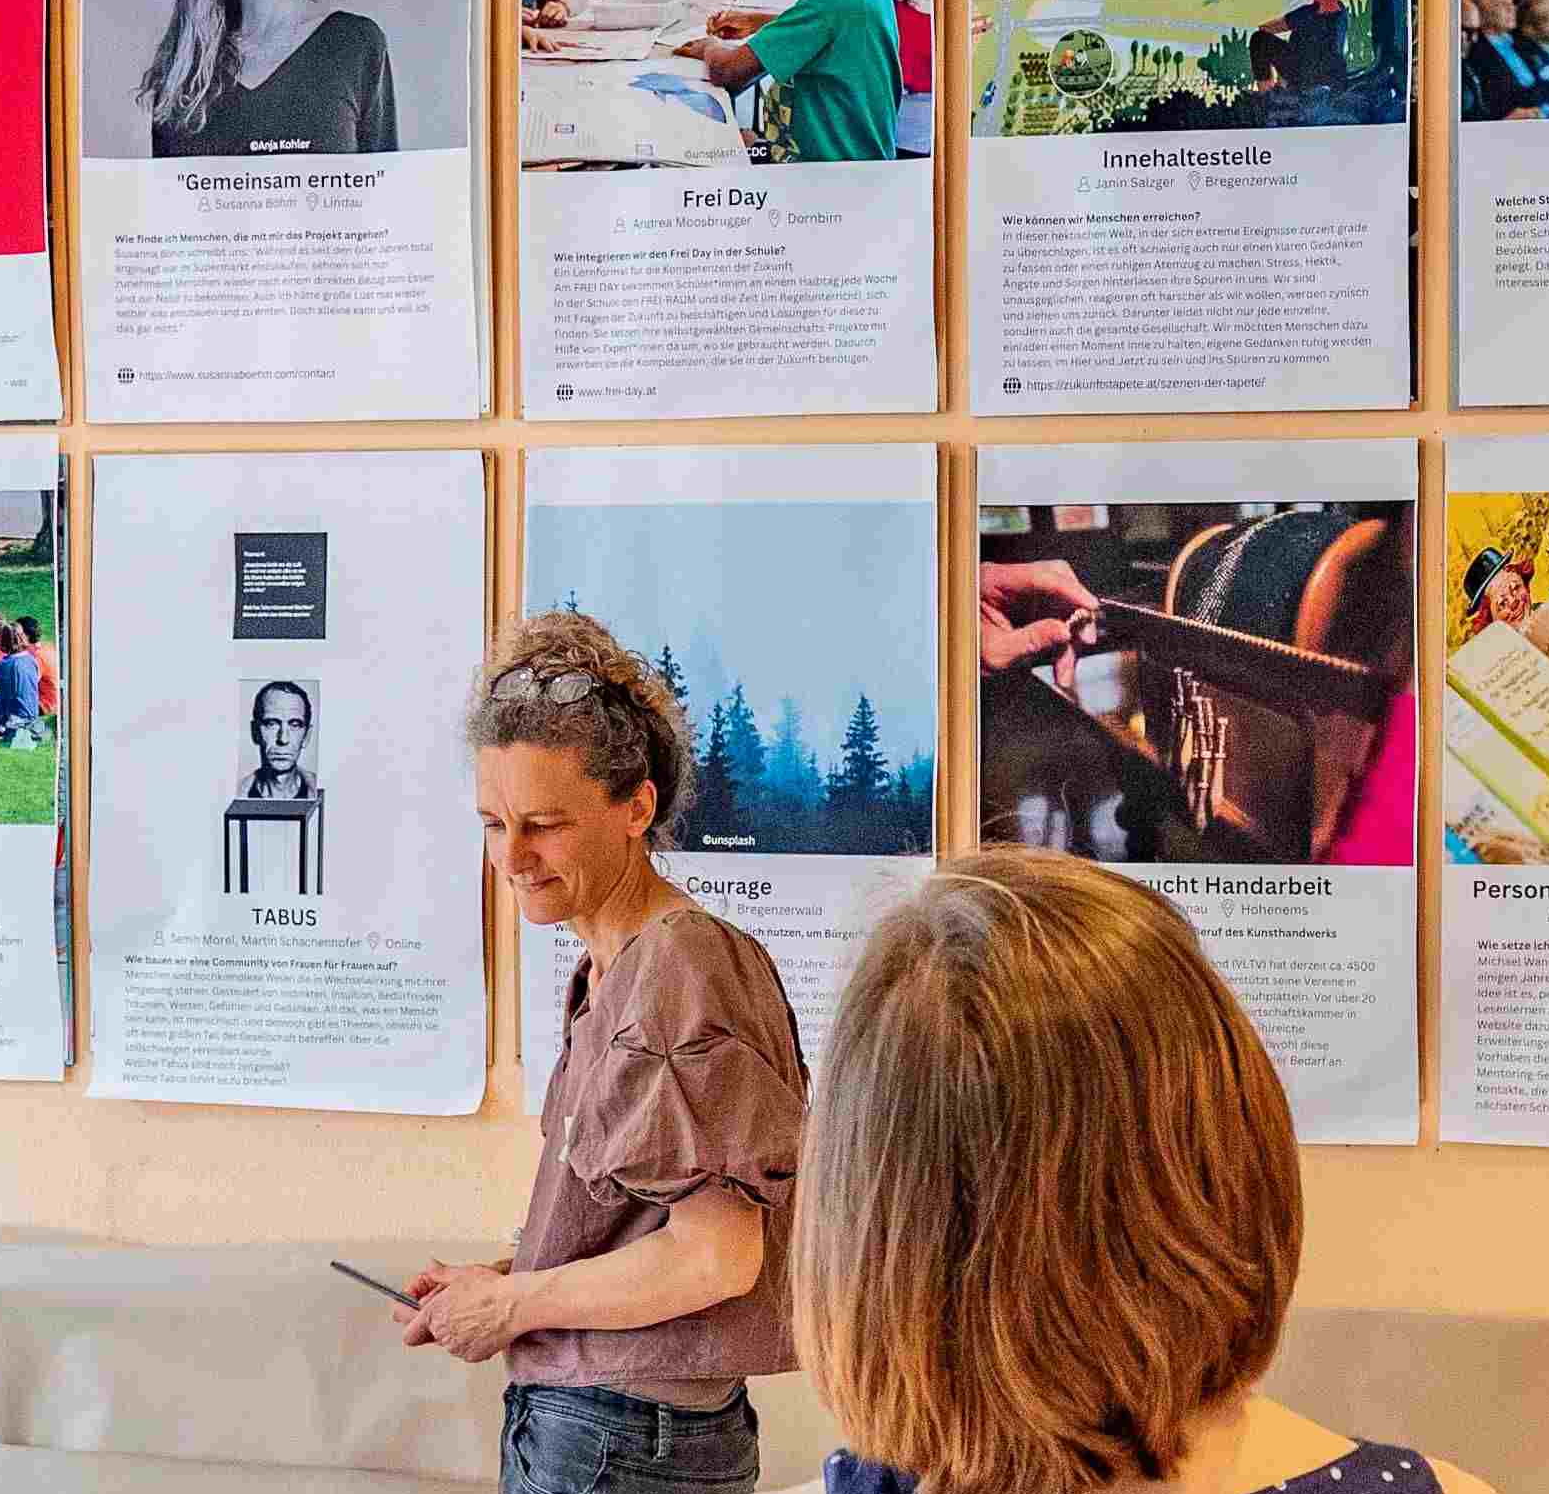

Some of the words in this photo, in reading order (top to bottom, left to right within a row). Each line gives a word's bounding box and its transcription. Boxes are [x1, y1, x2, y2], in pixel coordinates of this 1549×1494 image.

[1103, 146, 1272, 169] Innehaltestelle
[177, 173, 301, 191] "Gemeinsam
[307, 170, 385, 189] ernten"
[1205, 172, 1299, 190] Bregenzerwald
[322, 195, 363, 212] Lindau
[683, 188, 722, 208] Frei
[728, 188, 768, 211] Day
[1494, 195, 1536, 207] Welche
[675, 215, 753, 229] Moosbrugger
[787, 211, 843, 225] Dornbirn
[686, 876, 773, 900] Courage
[1205, 875, 1333, 896] Handarbeit
[251, 908, 317, 927] TABUS
[737, 903, 823, 918] Bregenzerwald
[1241, 903, 1309, 916] Hohenems
[1225, 927, 1244, 938] des
[1246, 927, 1337, 939] Kunsthandwerks
